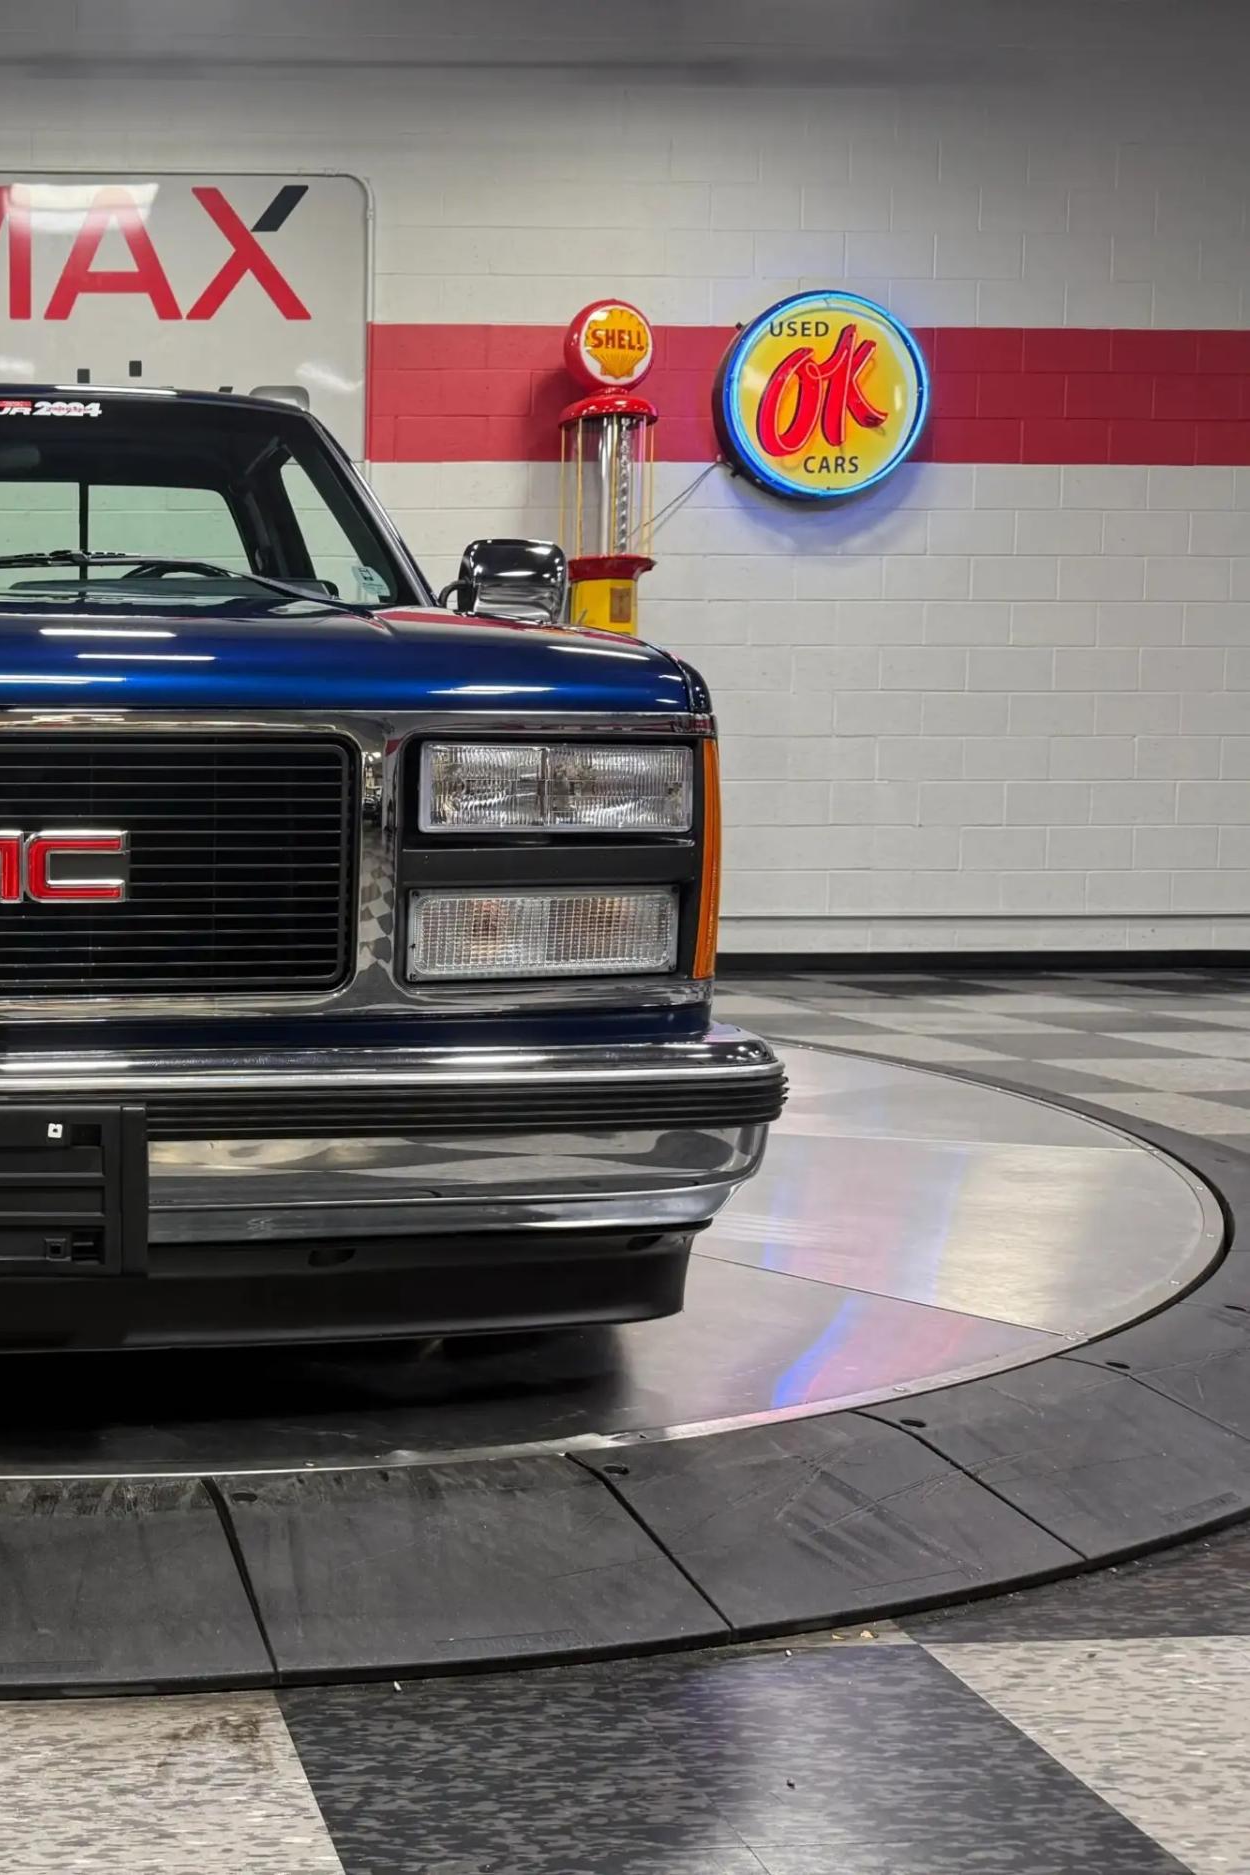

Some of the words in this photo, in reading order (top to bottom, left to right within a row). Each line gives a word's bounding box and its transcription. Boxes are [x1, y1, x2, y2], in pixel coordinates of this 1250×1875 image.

[769, 321, 830, 337] USED
[590, 328, 645, 351] SHELL
[756, 323, 889, 457] OK
[33, 401, 102, 417] 2024
[803, 455, 859, 473] CARS
